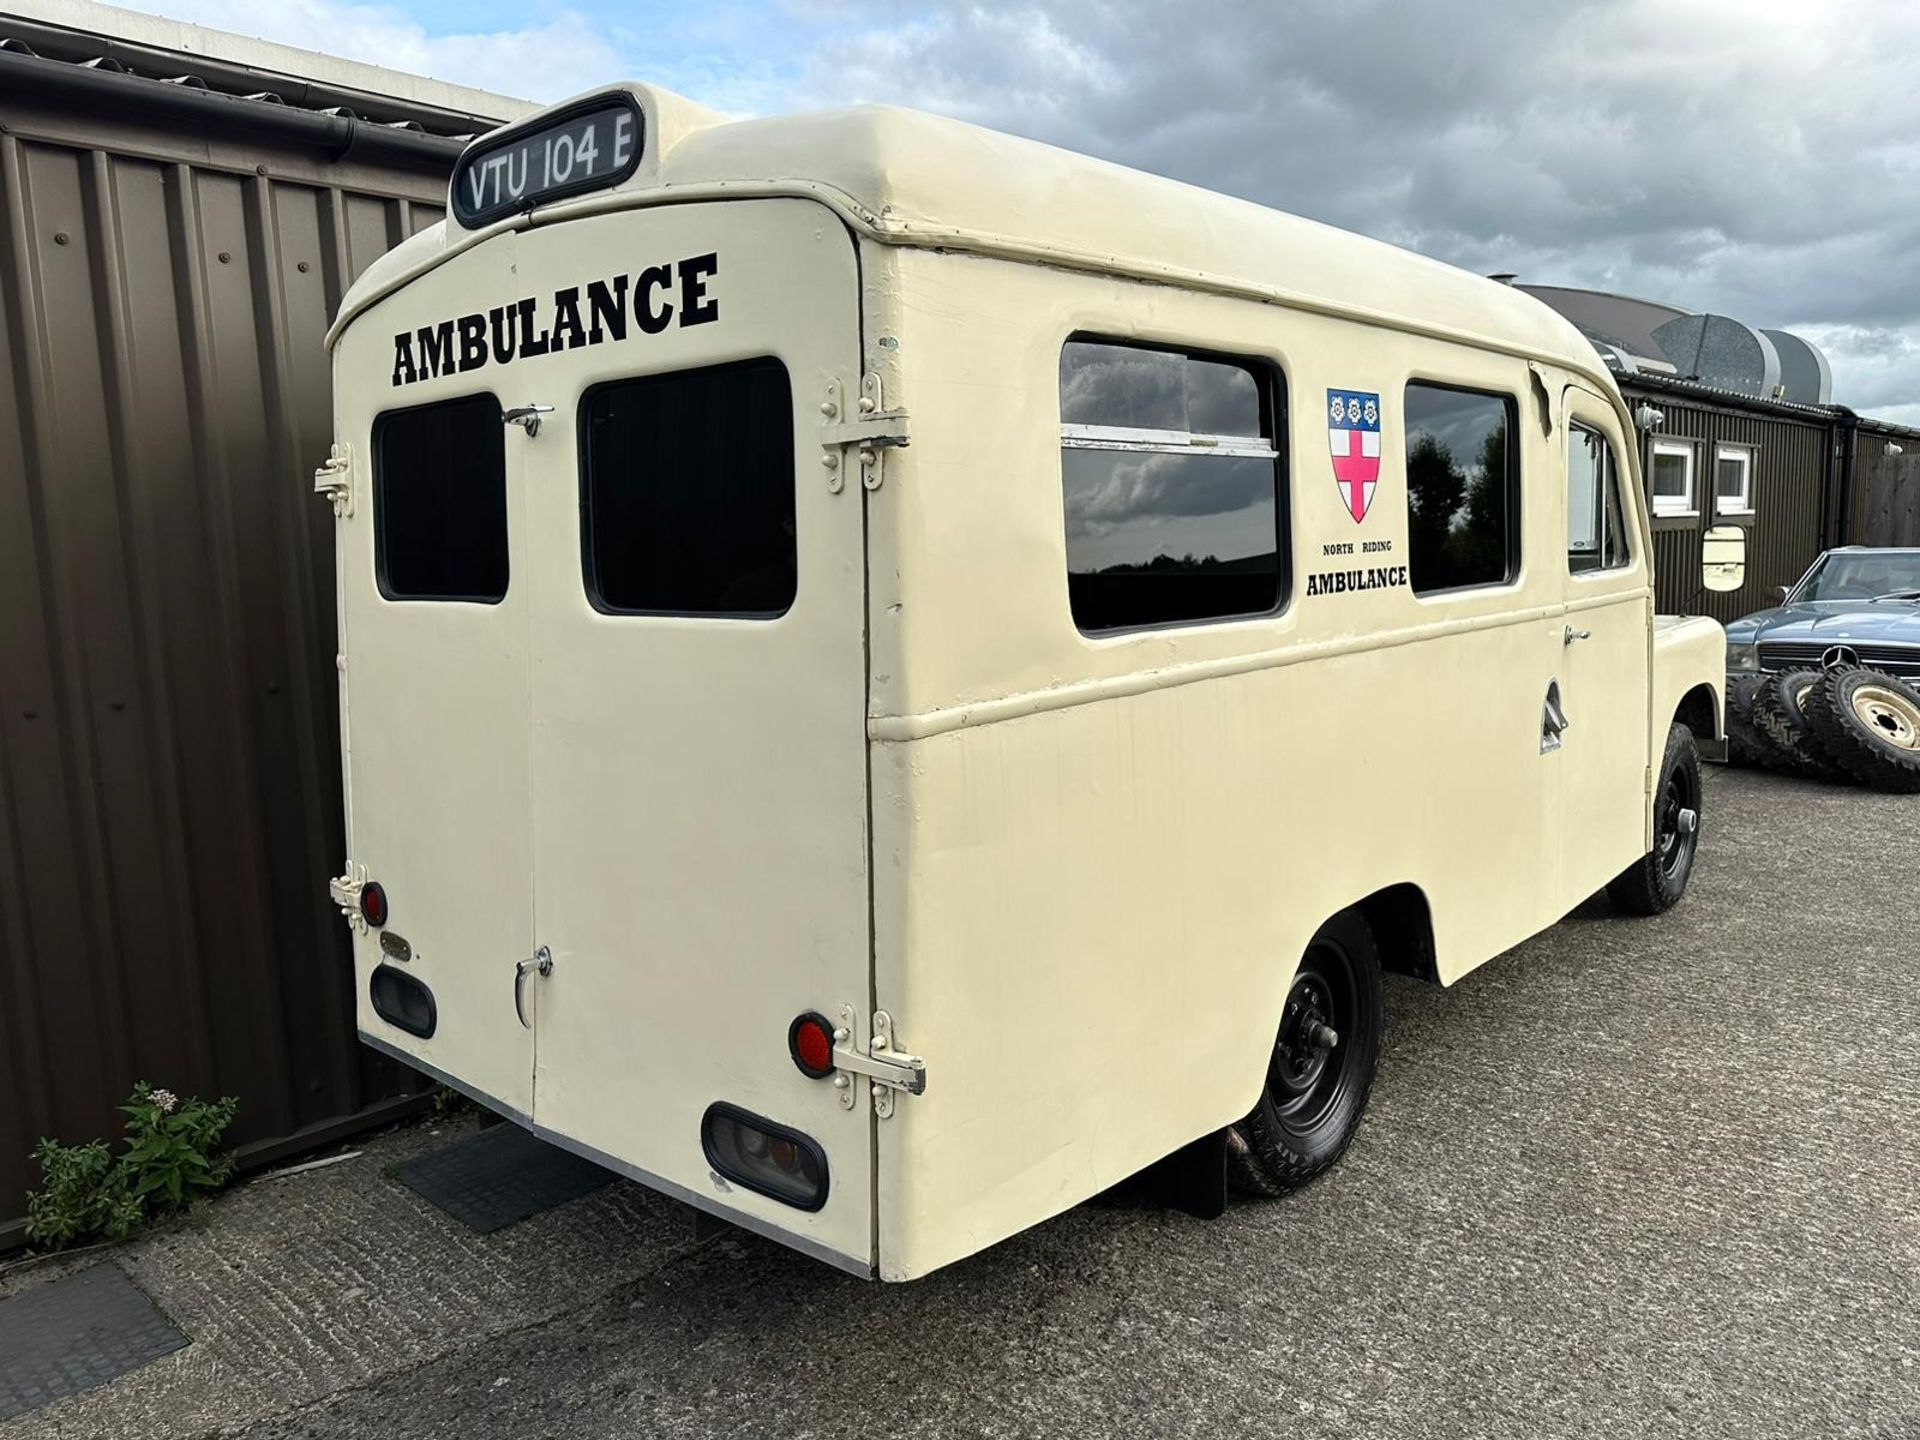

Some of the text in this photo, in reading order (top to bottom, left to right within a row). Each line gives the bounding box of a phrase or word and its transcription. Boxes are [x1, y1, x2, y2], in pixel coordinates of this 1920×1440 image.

[469, 112, 632, 210] VTU 104 E
[392, 252, 719, 386] AMBULANCE
[1323, 540, 1392, 556] NORTH RIDING
[1306, 566, 1407, 596] AMBULANCE
